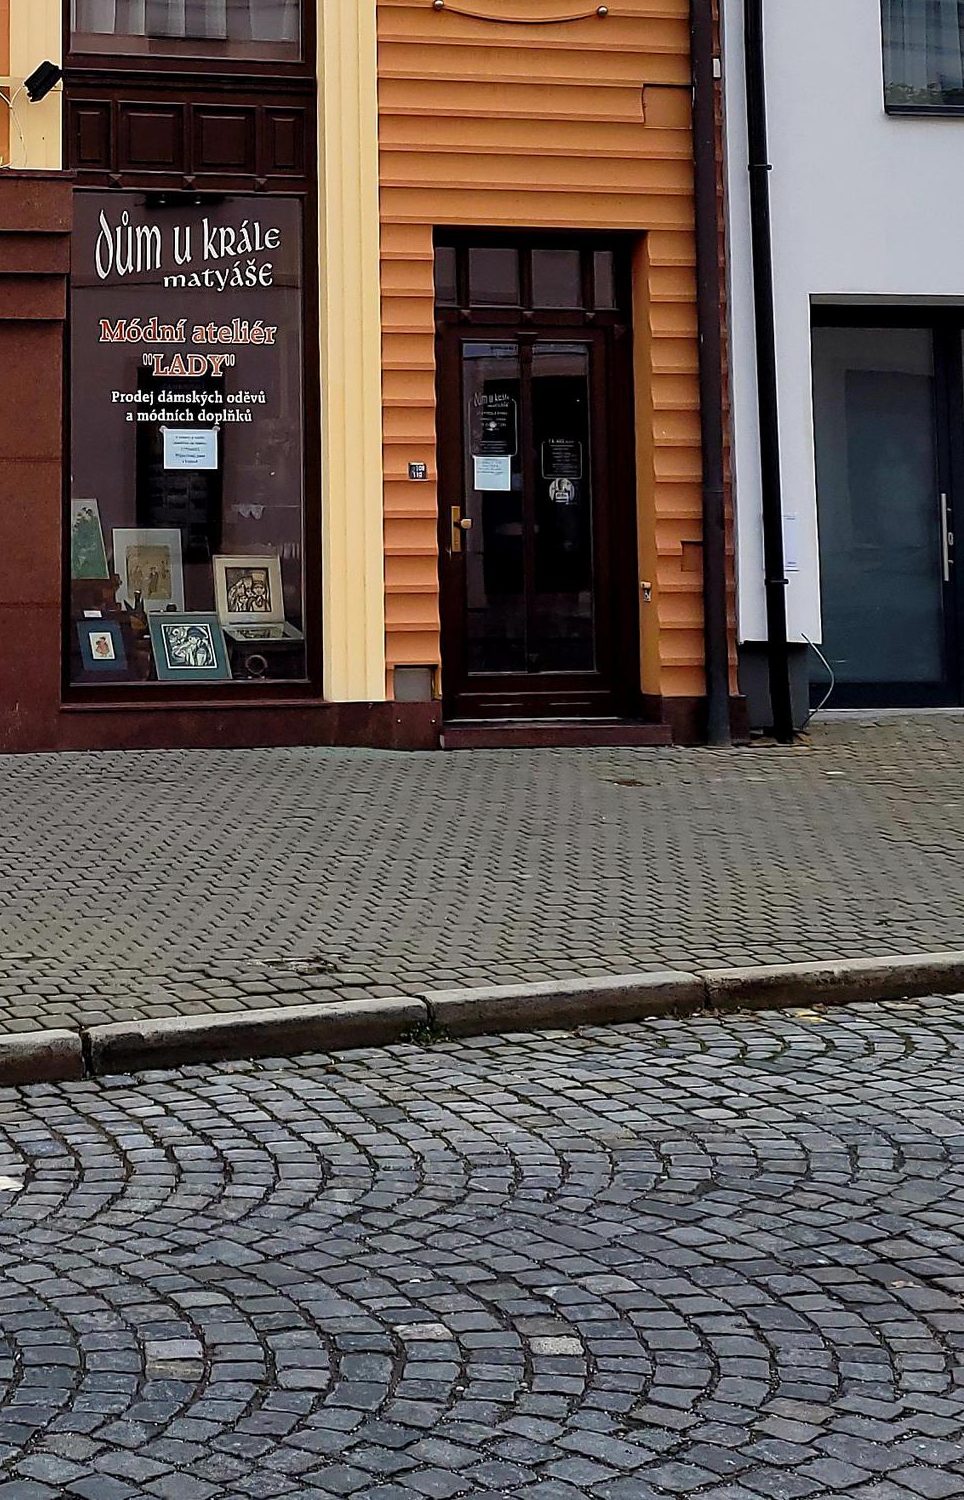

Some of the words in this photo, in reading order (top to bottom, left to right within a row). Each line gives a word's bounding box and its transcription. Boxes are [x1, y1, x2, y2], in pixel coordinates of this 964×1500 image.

[173, 226, 192, 265] u
[99, 317, 187, 342] Módní
[191, 318, 278, 344] ateliér
[142, 353, 236, 377] "LADY"
[111, 390, 154, 406] Prodej
[157, 390, 223, 406] dámských
[226, 390, 267, 404] oděvů
[126, 411, 134, 421] a
[137, 409, 194, 422] módních
[197, 408, 253, 425] doplňků
